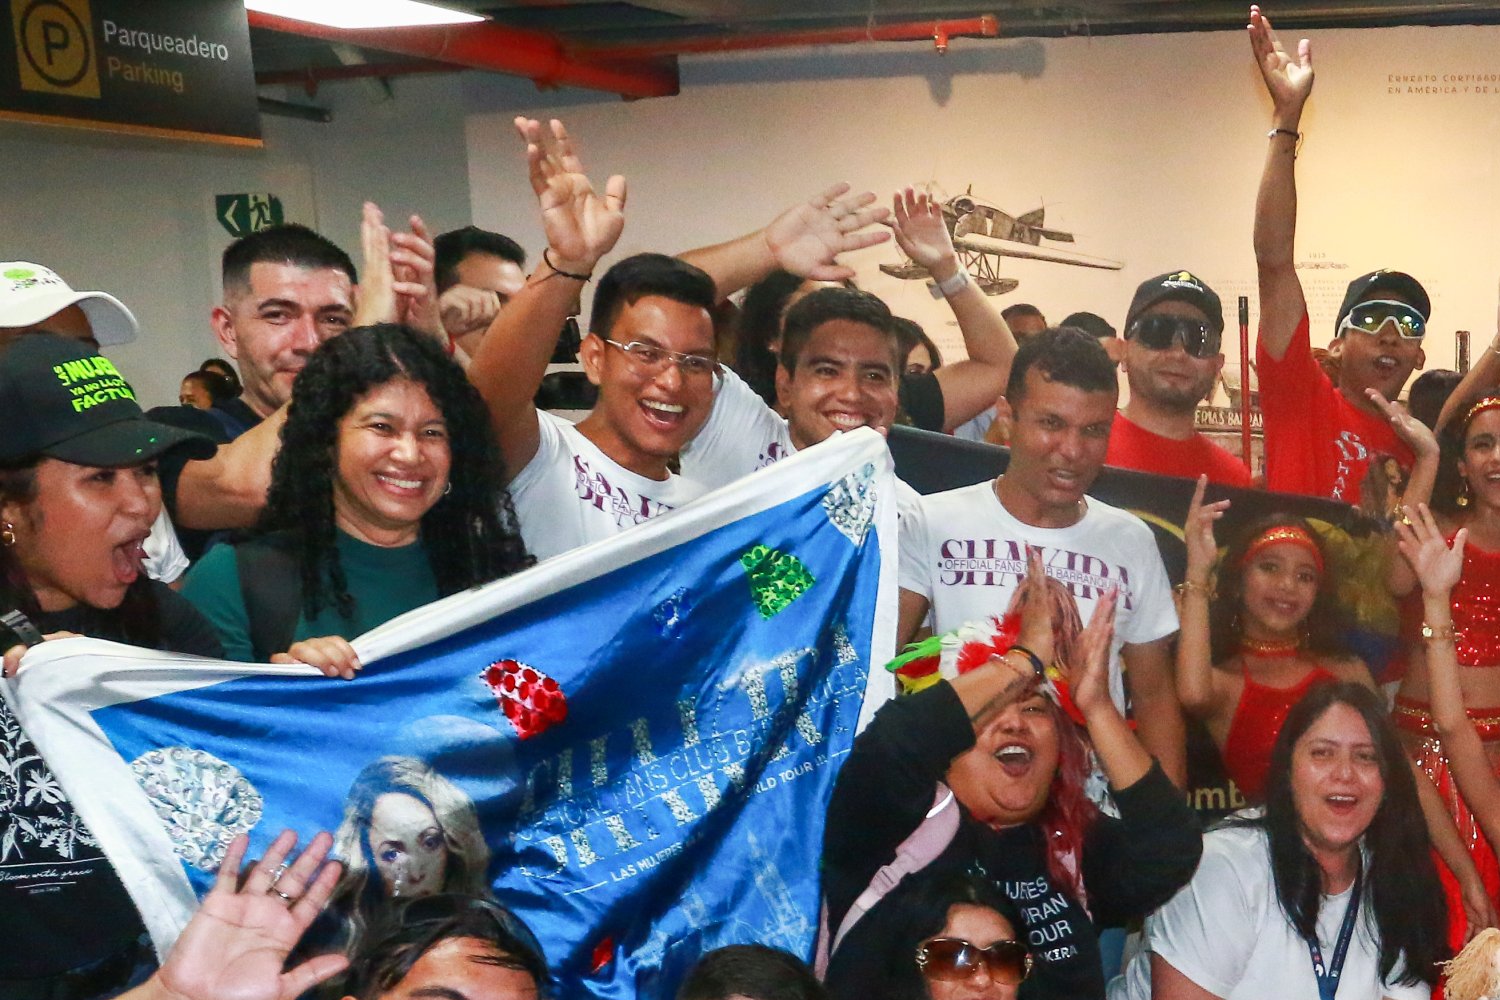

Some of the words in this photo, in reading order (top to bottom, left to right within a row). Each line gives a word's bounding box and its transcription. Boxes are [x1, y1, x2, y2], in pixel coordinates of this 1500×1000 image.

[102, 19, 229, 61] Parqueadero
[107, 56, 184, 93] Parking
[944, 558, 993, 571] OFFICIAL
[994, 560, 1023, 574] FANS
[610, 861, 638, 883] LAS
[779, 761, 814, 784] TOUR
